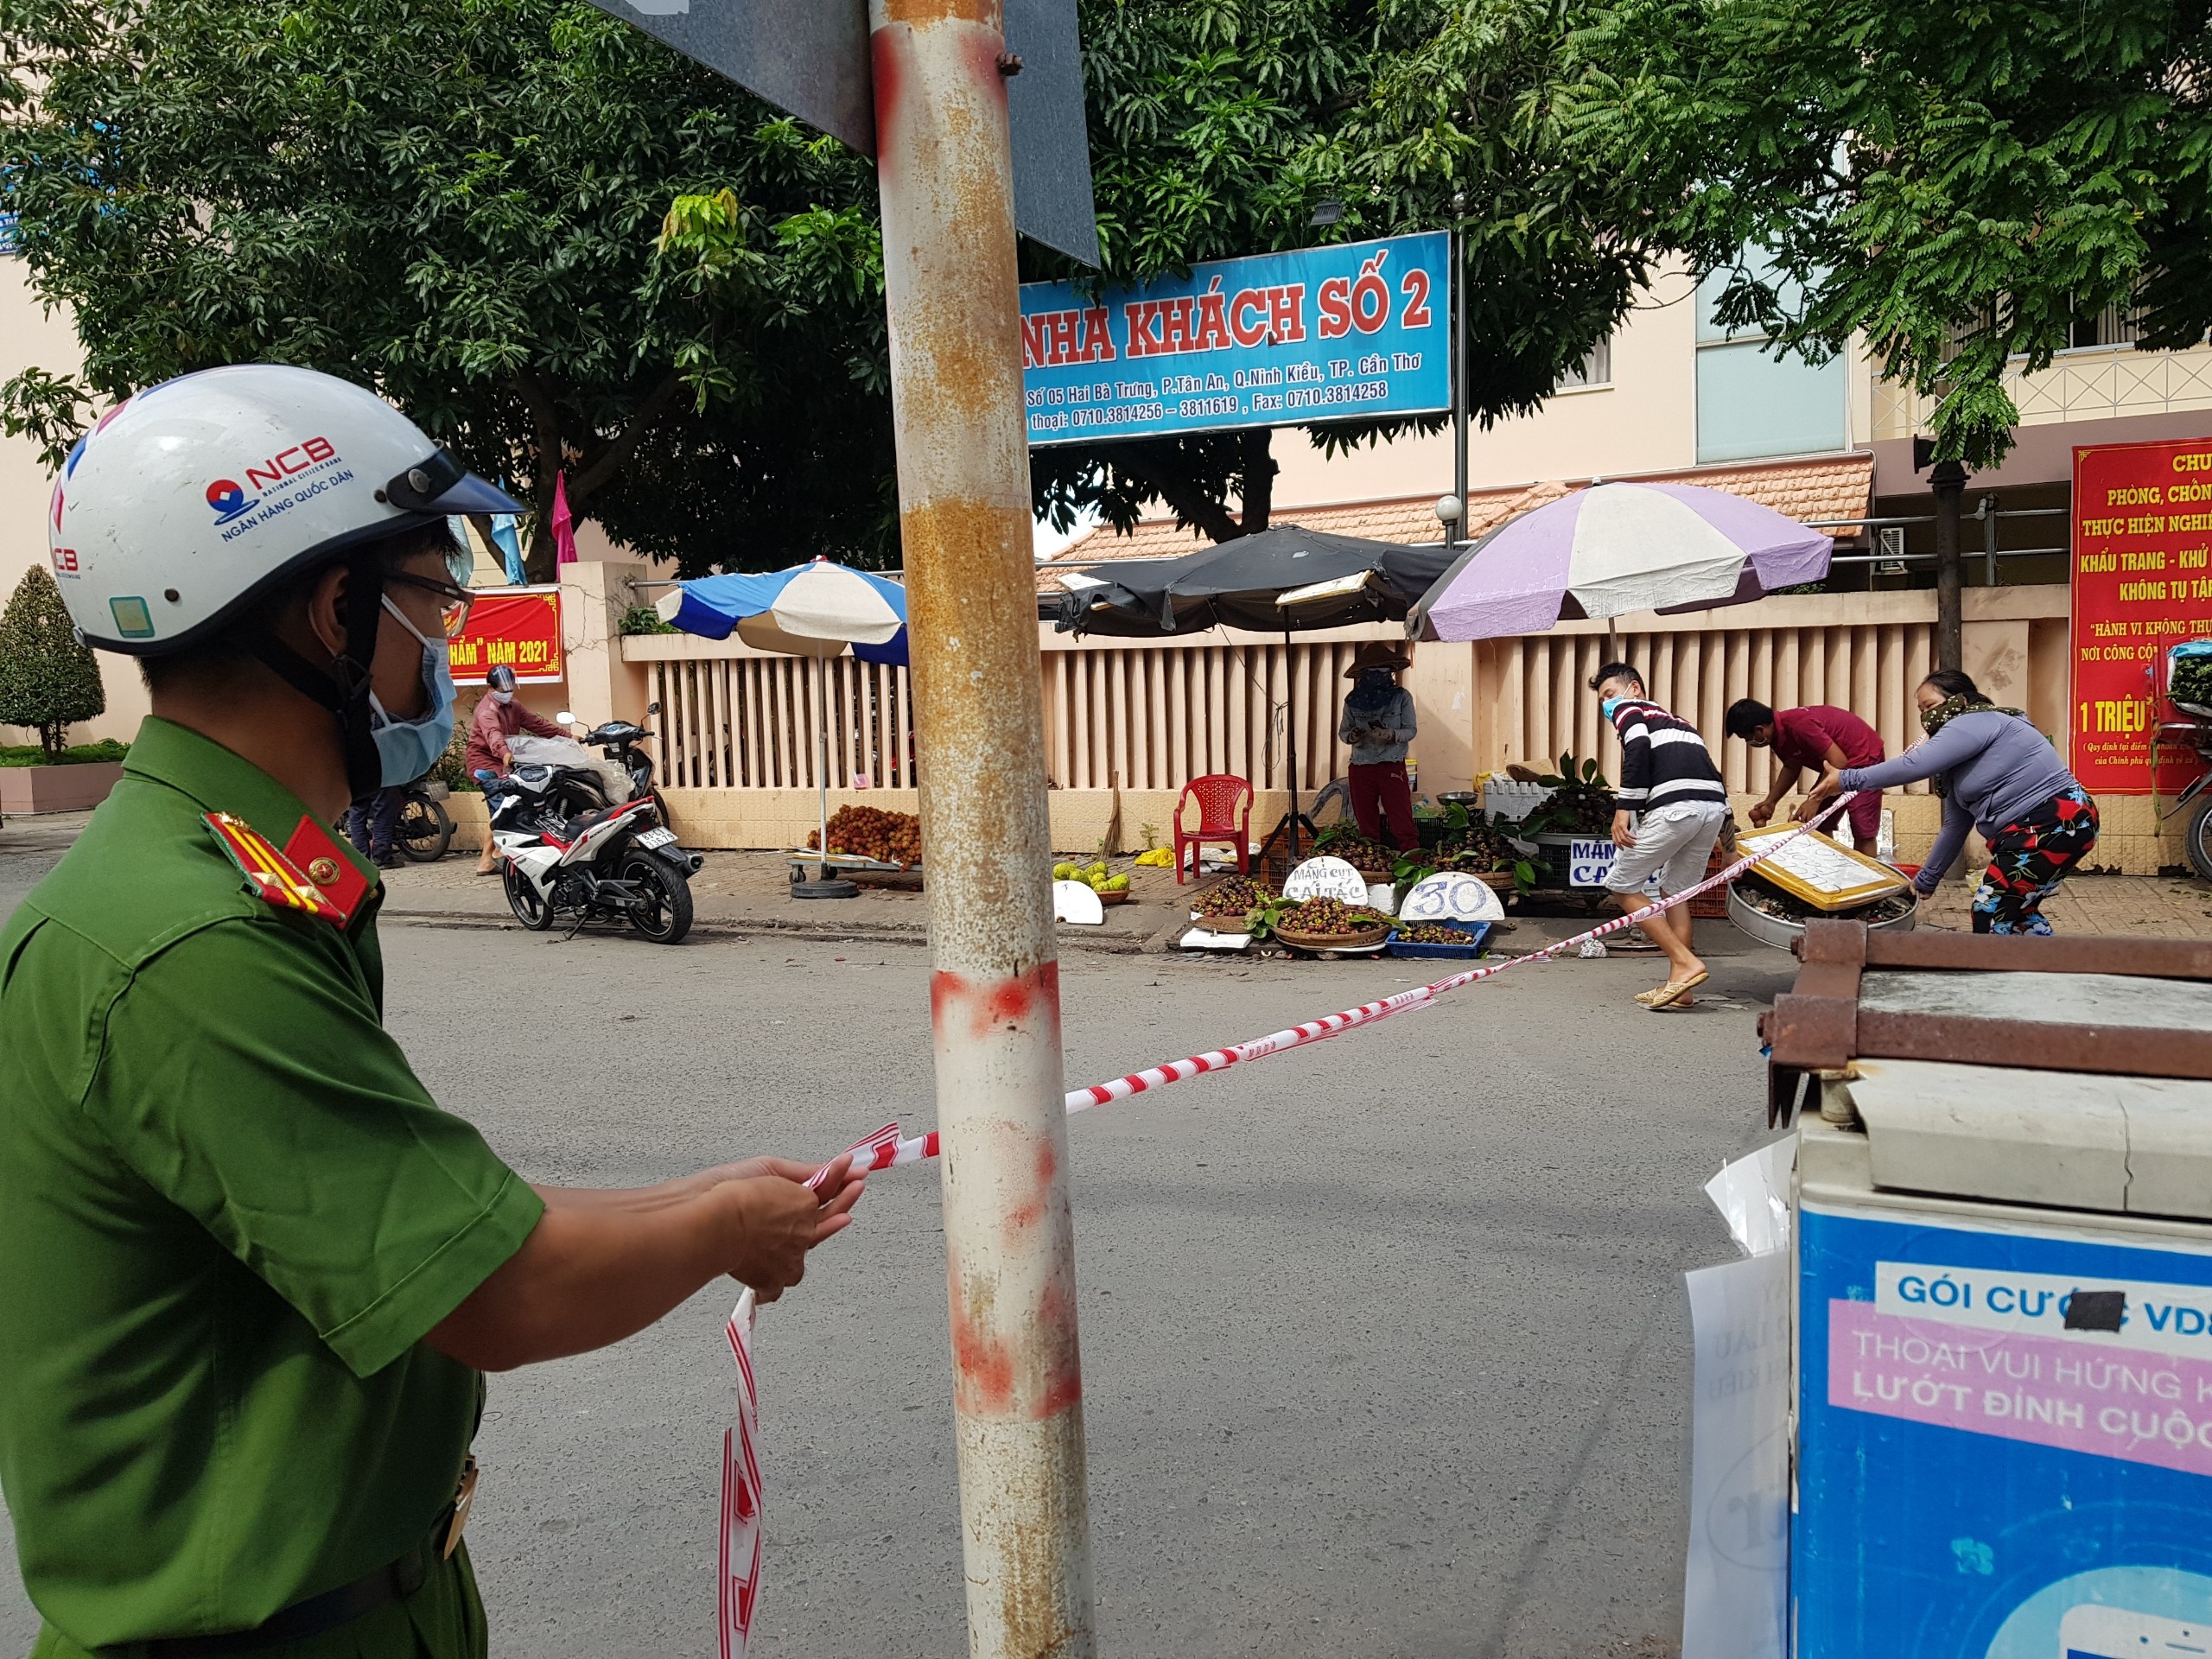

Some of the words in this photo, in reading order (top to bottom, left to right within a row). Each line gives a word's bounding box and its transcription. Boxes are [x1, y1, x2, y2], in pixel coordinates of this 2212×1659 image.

[1125, 275, 1306, 356] KHÁCH
[1319, 251, 1390, 340] SỐ
[1402, 268, 1431, 328] 2
[1027, 387, 1044, 406] Số
[1048, 388, 1064, 404] 05
[1068, 385, 1090, 403] Hai
[1095, 383, 1110, 400] Bà
[1116, 381, 1158, 399] Trưng,
[1162, 377, 1202, 394] P.Tân
[1206, 373, 1230, 391] An,
[1234, 369, 1282, 388] Q.Ninh
[1287, 361, 1325, 383] Kiều,
[1330, 360, 1355, 378] TP.
[1359, 353, 1388, 374] Cần
[1393, 353, 1422, 371] Thơ
[1032, 412, 1069, 431] thoại:
[1071, 404, 1163, 427] 0710.3814256
[1180, 397, 1238, 418] 3811619
[1254, 394, 1284, 412] Fax:
[1287, 381, 1389, 407] 0710.3814258
[245, 436, 335, 490] NCB
[221, 517, 258, 543] NGÂN
[257, 499, 295, 522] HÀNG
[295, 480, 329, 503] QUỐC
[328, 469, 354, 486] DÂN
[2107, 484, 2164, 506] PHÒNG,
[2082, 517, 2125, 539] THỰC
[2127, 512, 2164, 537] HIỆN
[2081, 547, 2117, 573] KHẨU
[2120, 551, 2165, 571] TRANG
[2179, 543, 2209, 569] KHỬ
[2120, 578, 2166, 601] KHÔNG
[2171, 580, 2188, 602] TỤ
[2130, 622, 2142, 636] VI
[2145, 618, 2186, 636] KHÔNG
[486, 638, 516, 664] NĂM
[519, 640, 548, 663] 2021
[2081, 646, 2101, 661] NƠI
[2103, 644, 2134, 660] CÔNG
[2080, 701, 2088, 733] 1
[2094, 694, 2146, 740] TRIỆU
[1573, 839, 1618, 860] MĂN
[1413, 880, 1487, 916] 30
[1897, 1273, 1972, 1310] GÓI
[2145, 1303, 2212, 1337] VD
[1853, 1331, 1967, 1372] THOẠI
[1980, 1347, 2040, 1381] VUI
[2055, 1356, 2182, 1400] HỨNG
[1853, 1370, 1973, 1412] LƯỚT
